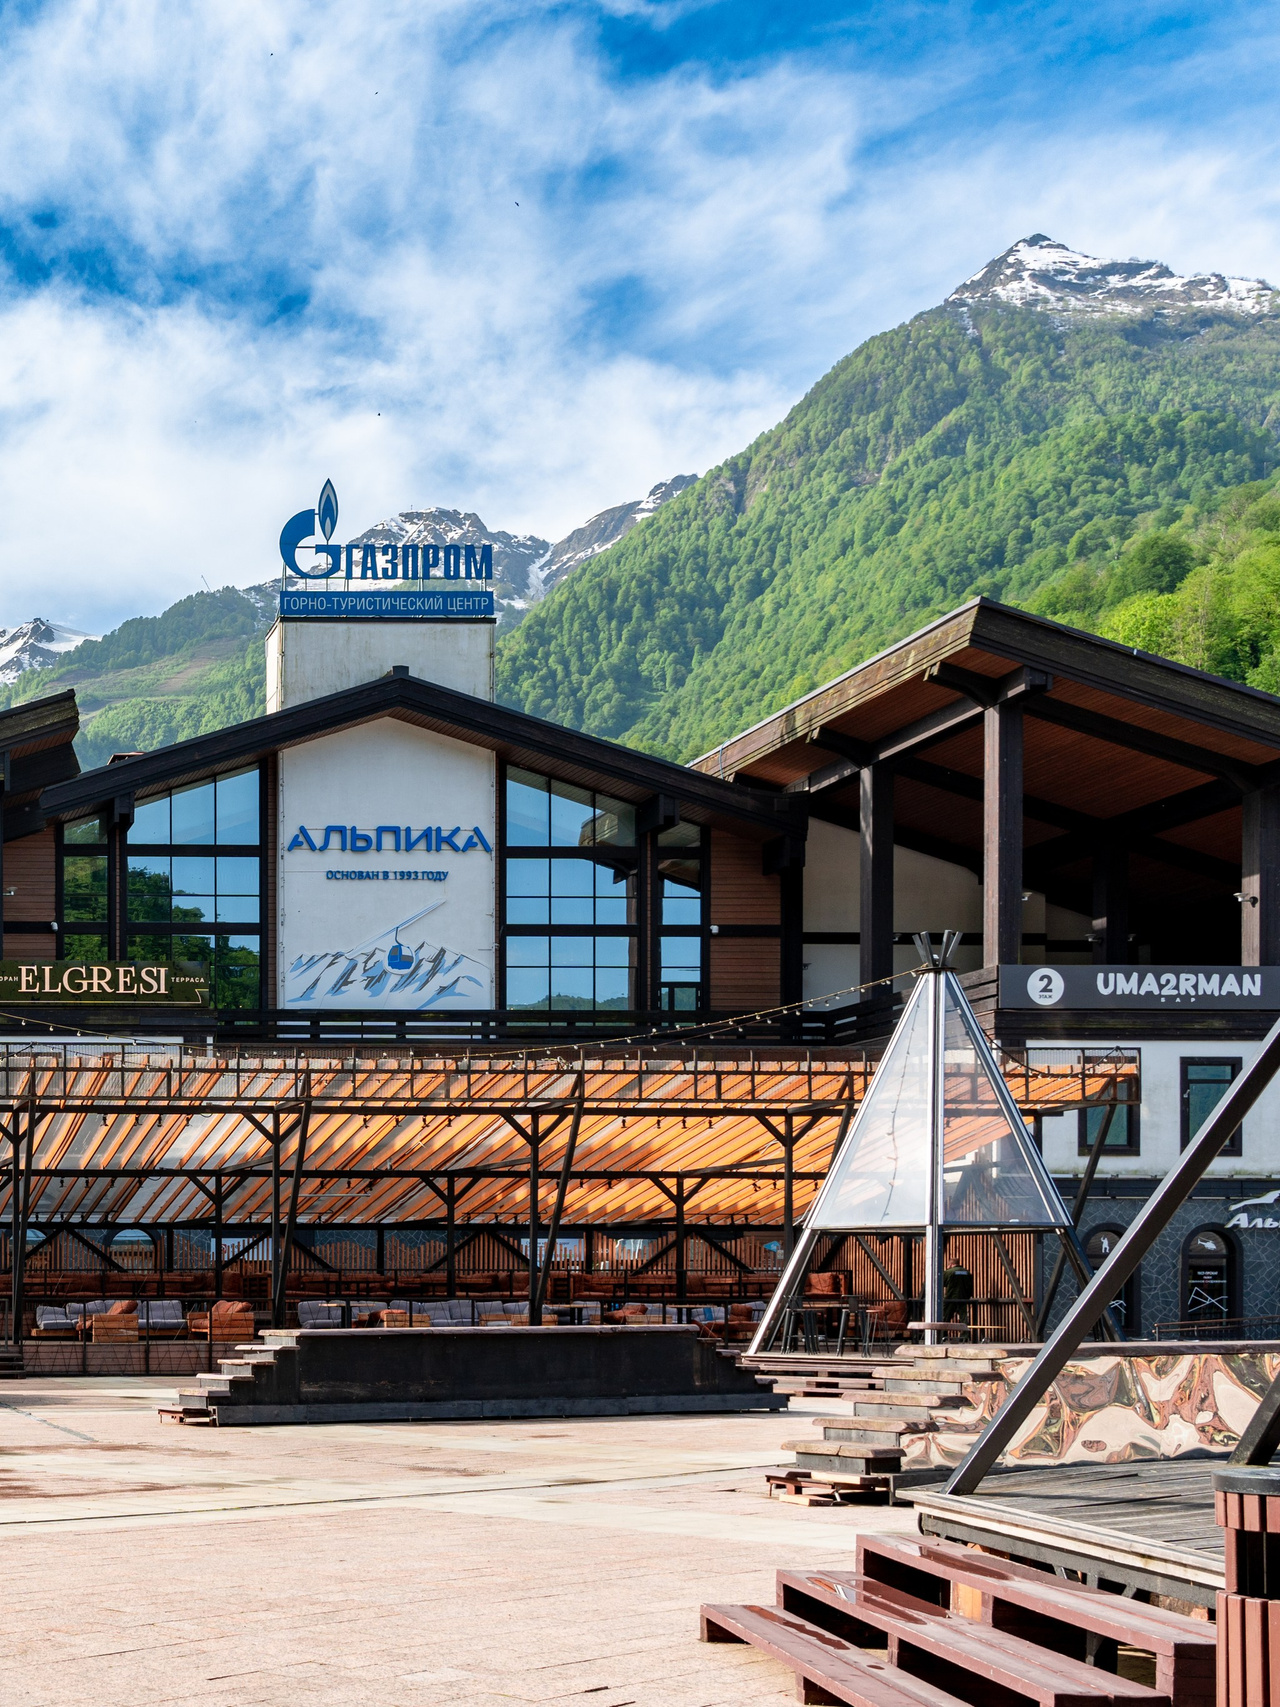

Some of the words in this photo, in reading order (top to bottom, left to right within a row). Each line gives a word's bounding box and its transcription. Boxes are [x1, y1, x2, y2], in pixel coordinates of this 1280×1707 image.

[345, 544, 493, 580] ГАЗПРОМ
[285, 596, 442, 610] ГОРНО-ТУРИСТИЧЕСКИЙ
[448, 598, 488, 612] ЦЕНТР
[287, 825, 492, 853] АЛЬПИКА
[326, 870, 379, 880] ОСНОВАН
[383, 871, 389, 880] В
[394, 871, 419, 880] 1993
[421, 871, 448, 882] ГОДУ
[17, 965, 169, 994] ELGRESI
[1038, 974, 1053, 993] 2
[1096, 972, 1262, 997] UMA2RMAN
